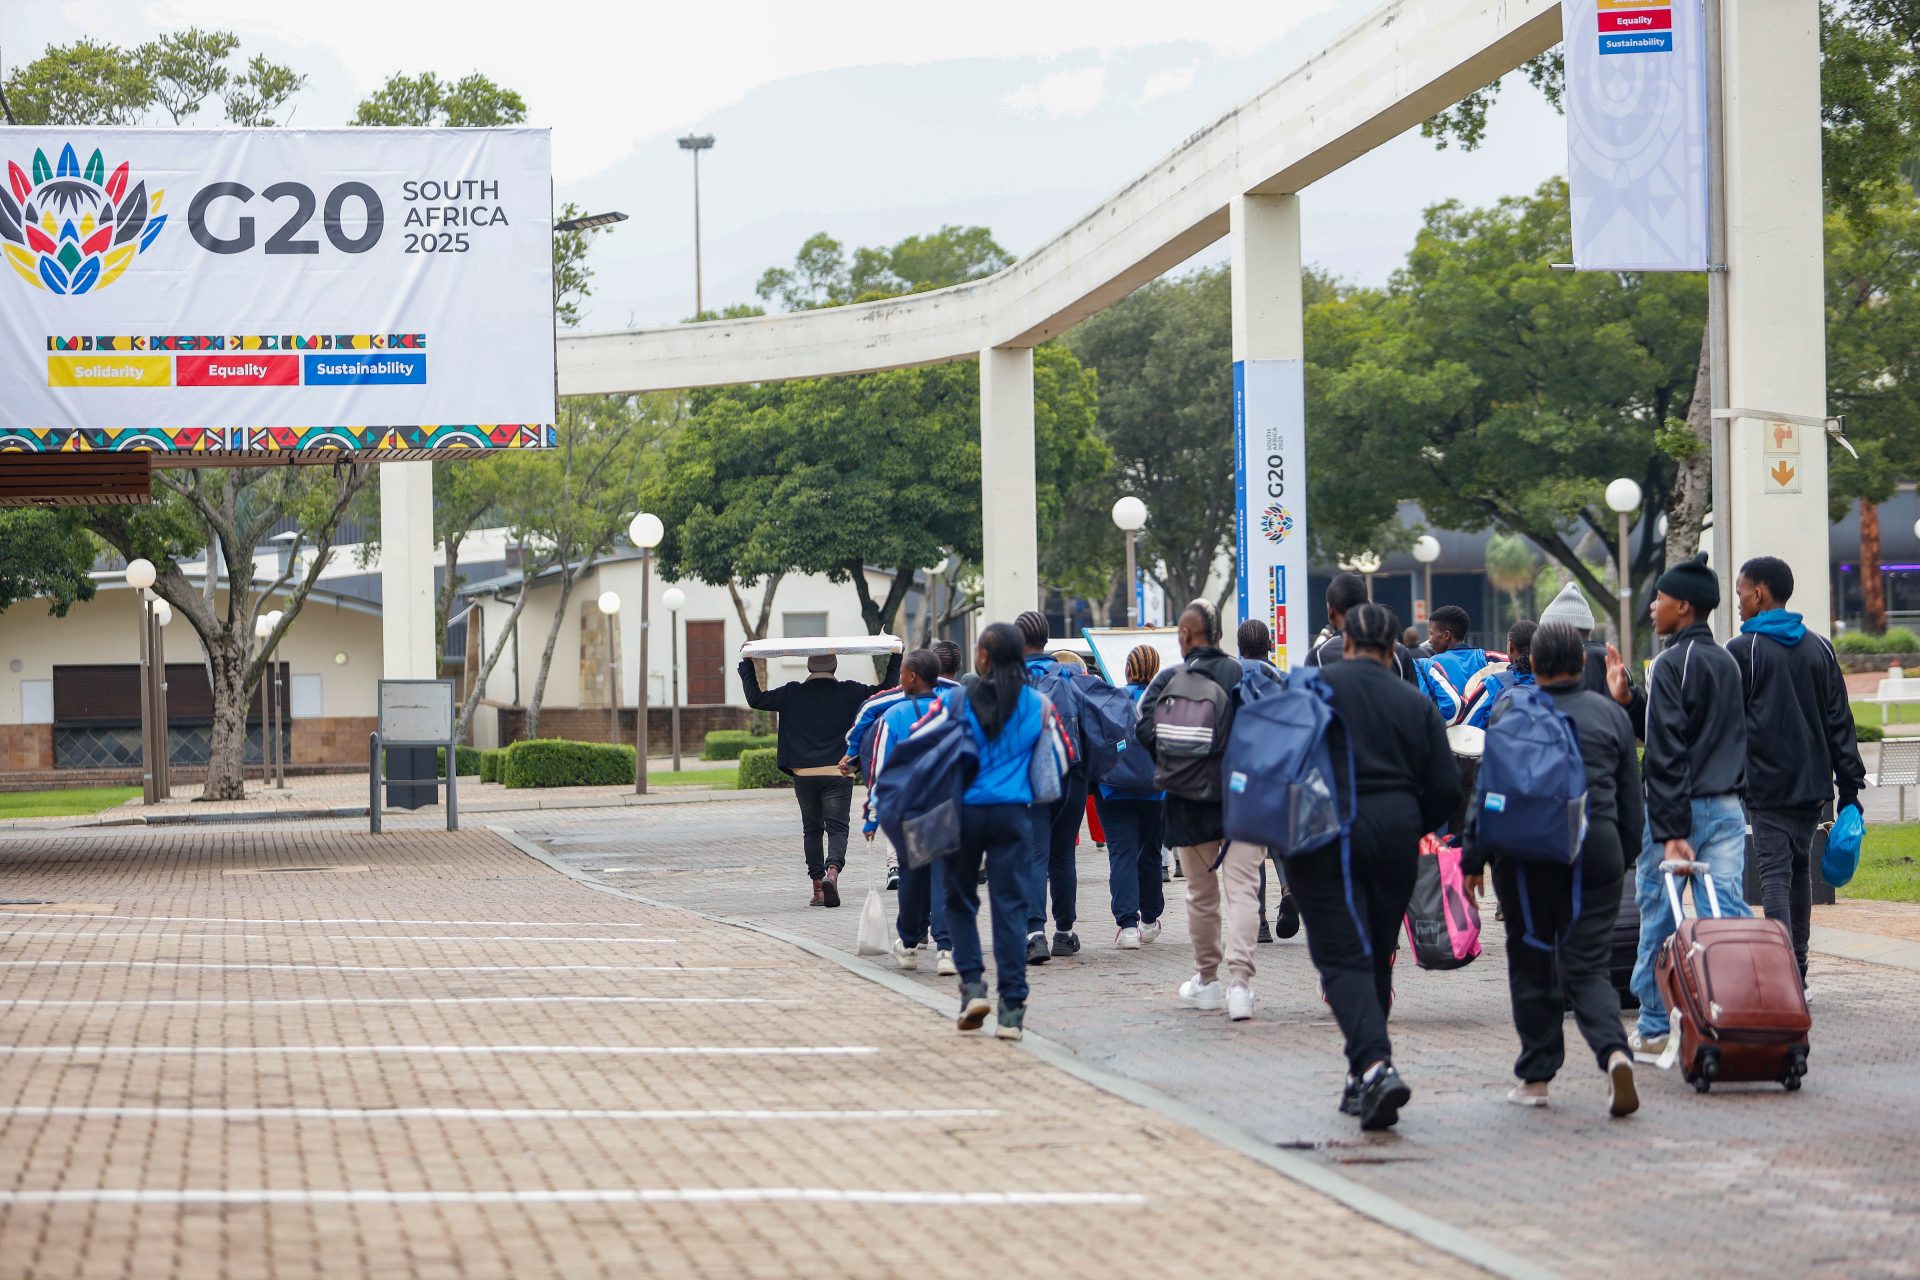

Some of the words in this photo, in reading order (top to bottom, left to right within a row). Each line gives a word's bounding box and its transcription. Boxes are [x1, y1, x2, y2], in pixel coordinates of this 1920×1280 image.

[1616, 15, 1653, 26] Equality
[1606, 37, 1665, 48] Sustainability
[402, 180, 499, 201] SOUTH
[187, 181, 385, 255] G20
[403, 206, 509, 227] AFRICA
[404, 232, 470, 254] 2025
[74, 364, 144, 381] Solidarity
[208, 363, 268, 379] Equality
[316, 361, 414, 377] Sustainability
[1267, 454, 1284, 498] G20
